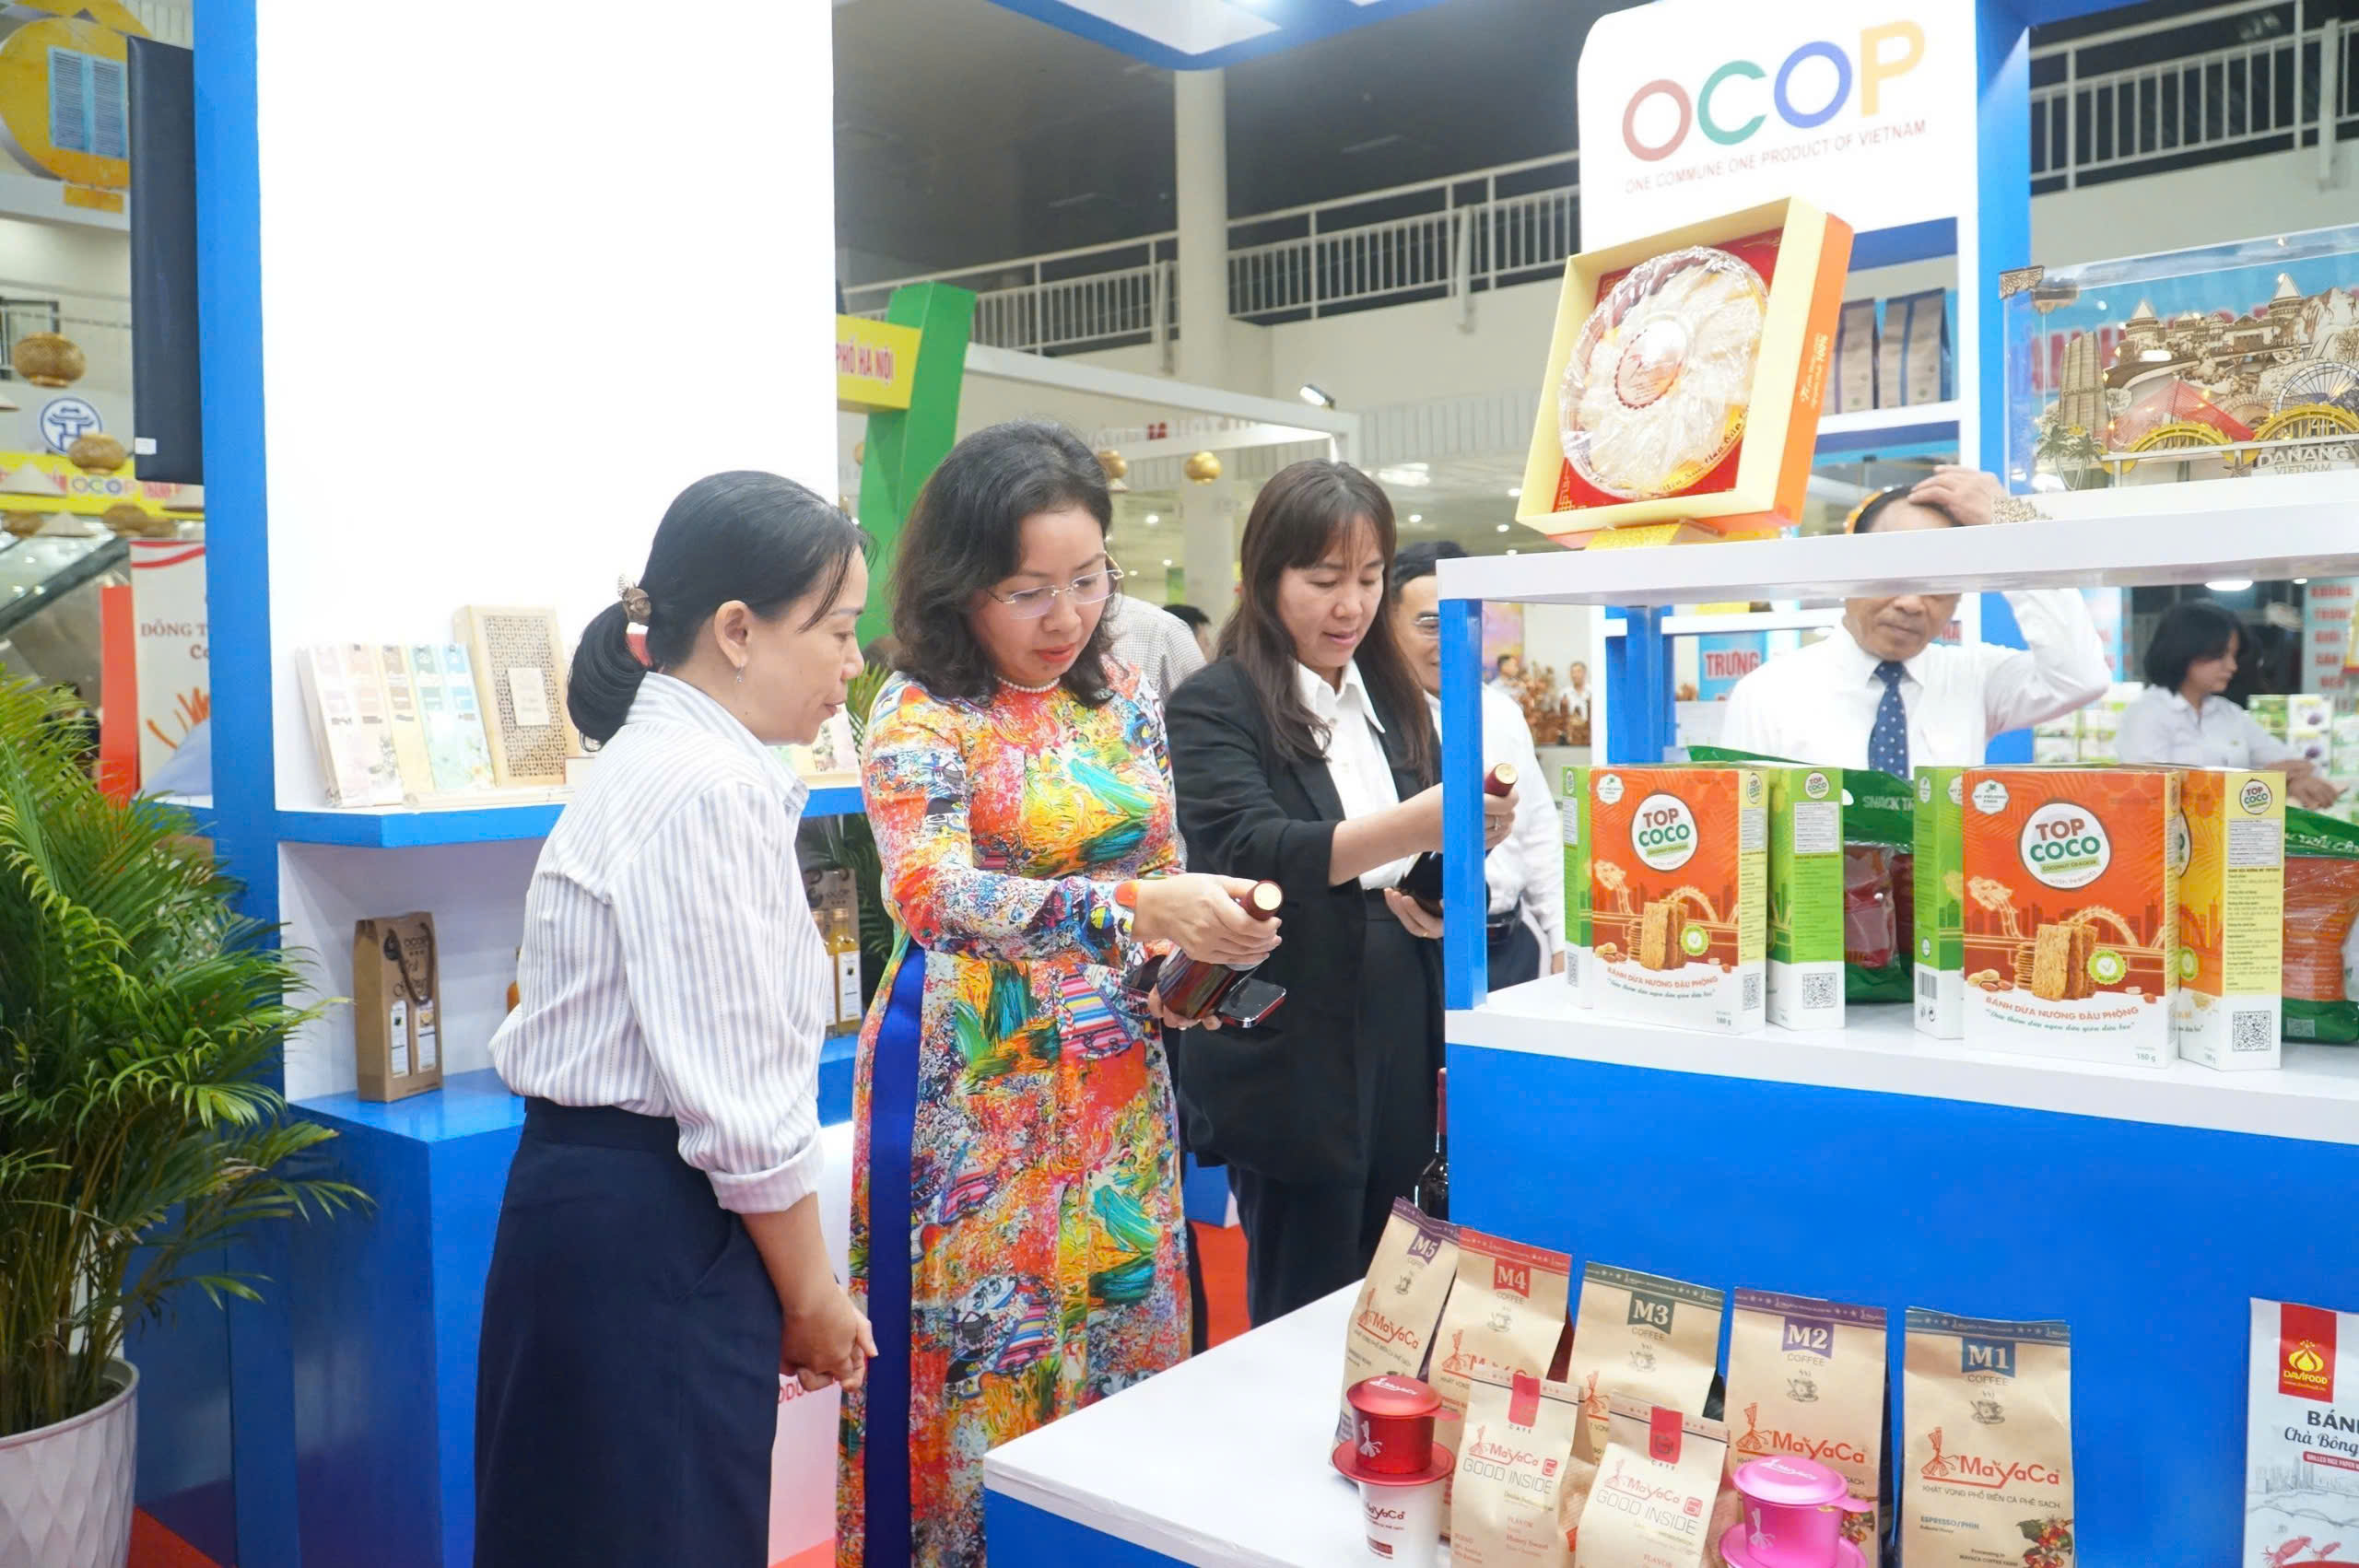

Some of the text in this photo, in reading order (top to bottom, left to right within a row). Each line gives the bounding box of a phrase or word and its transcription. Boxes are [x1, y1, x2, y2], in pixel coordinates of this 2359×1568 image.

[1623, 19, 1925, 161] OCOP
[1625, 120, 1926, 193] ONE COMMUNE ONE PRODUCT OF VIETNAM
[2244, 793, 2268, 804] COCO
[2247, 787, 2263, 796] TOP
[1643, 808, 1678, 828] TOP
[2036, 818, 2084, 840] TOP
[1638, 824, 1690, 847] COCO
[2030, 837, 2101, 862] COCO
[1412, 1235, 1438, 1258] M5
[1497, 1266, 1526, 1290] M4
[1496, 1291, 1525, 1305] COFFEE
[1633, 1299, 1669, 1325] M3
[1631, 1327, 1665, 1340] COFFEE
[1788, 1324, 1828, 1350] M2
[1788, 1352, 1825, 1366] COFFEE
[1967, 1344, 2009, 1369] M1
[1967, 1374, 2009, 1387] COFFEE
[2284, 1426, 2359, 1457] Chà Bông
[1462, 1457, 1554, 1494] GOOD INSIDE
[1596, 1489, 1642, 1515] GOOD
[1645, 1506, 1697, 1537] INSIDE
